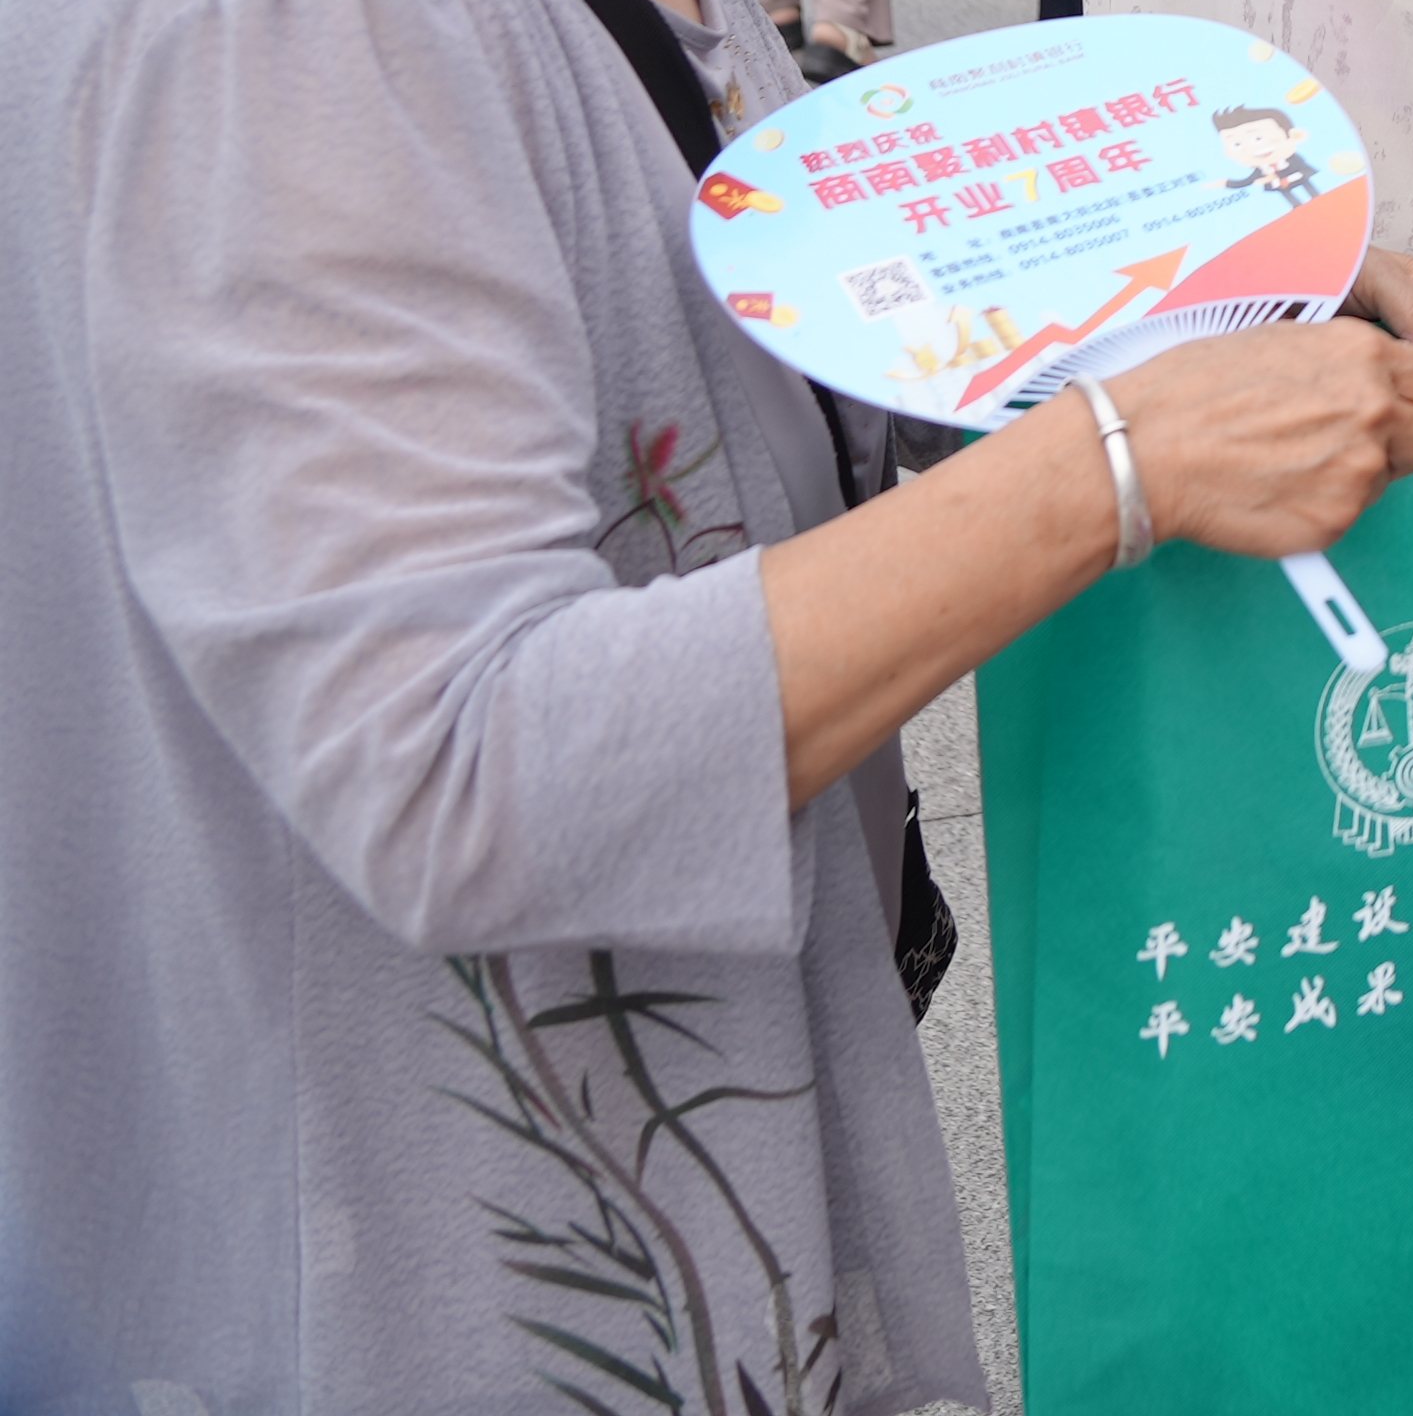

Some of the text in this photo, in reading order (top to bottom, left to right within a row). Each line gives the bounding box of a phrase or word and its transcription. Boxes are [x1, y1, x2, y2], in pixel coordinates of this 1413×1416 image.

[799, 121, 943, 174] 热烈庆祝
[808, 77, 1201, 210] 商南聚利村镇银行
[898, 138, 1153, 235] 开业7周年
[1137, 885, 1411, 982] 平安建设
[1138, 961, 1405, 1060] 平安成果
